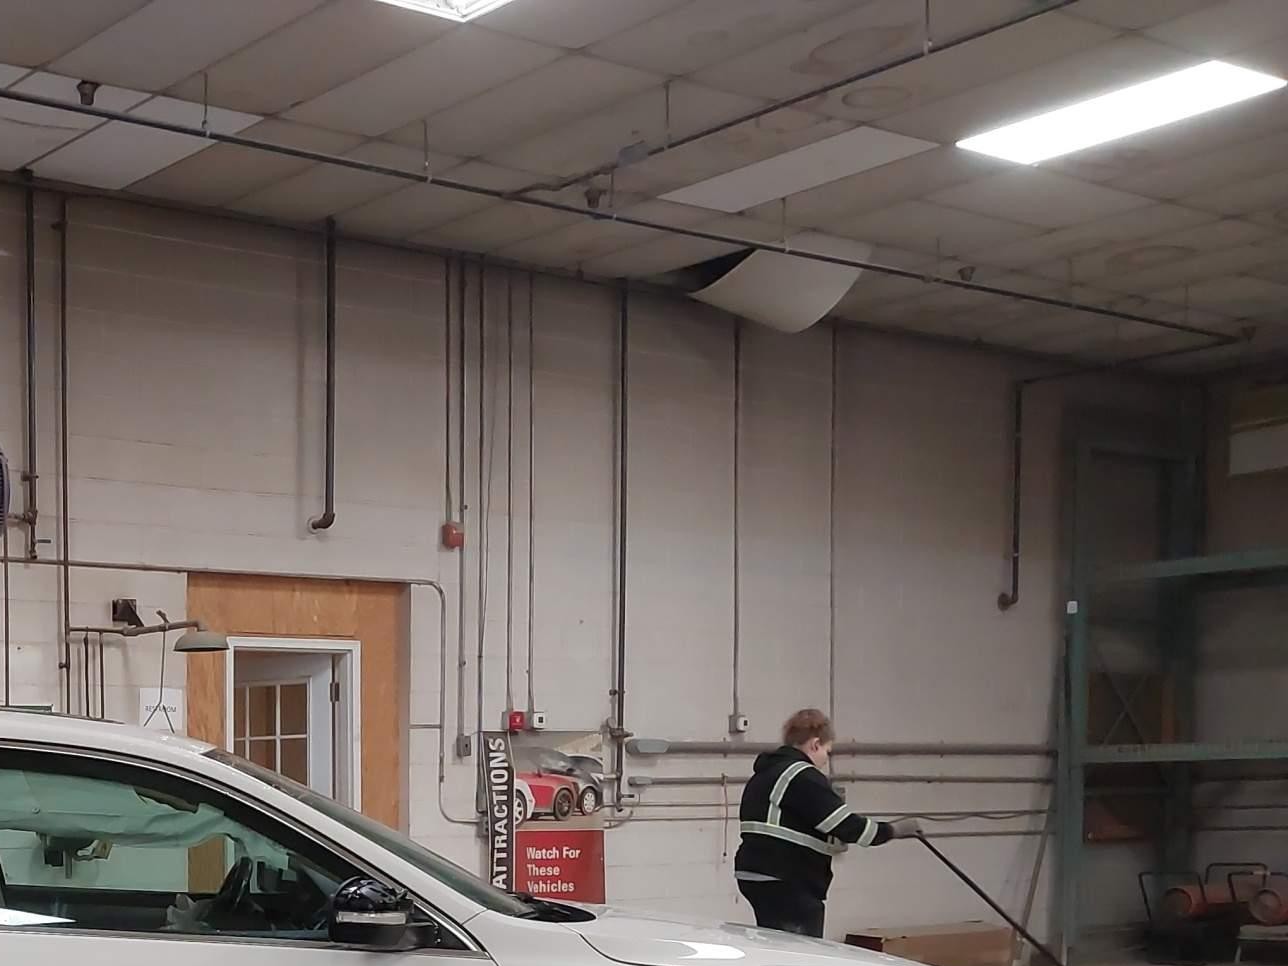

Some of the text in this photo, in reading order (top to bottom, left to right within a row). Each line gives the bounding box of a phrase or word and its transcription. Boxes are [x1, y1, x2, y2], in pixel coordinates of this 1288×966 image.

[488, 737, 509, 890] ATTRACTIONS
[526, 846, 581, 860] Watch For
[526, 863, 560, 876] These
[527, 880, 575, 893] Vehicles
